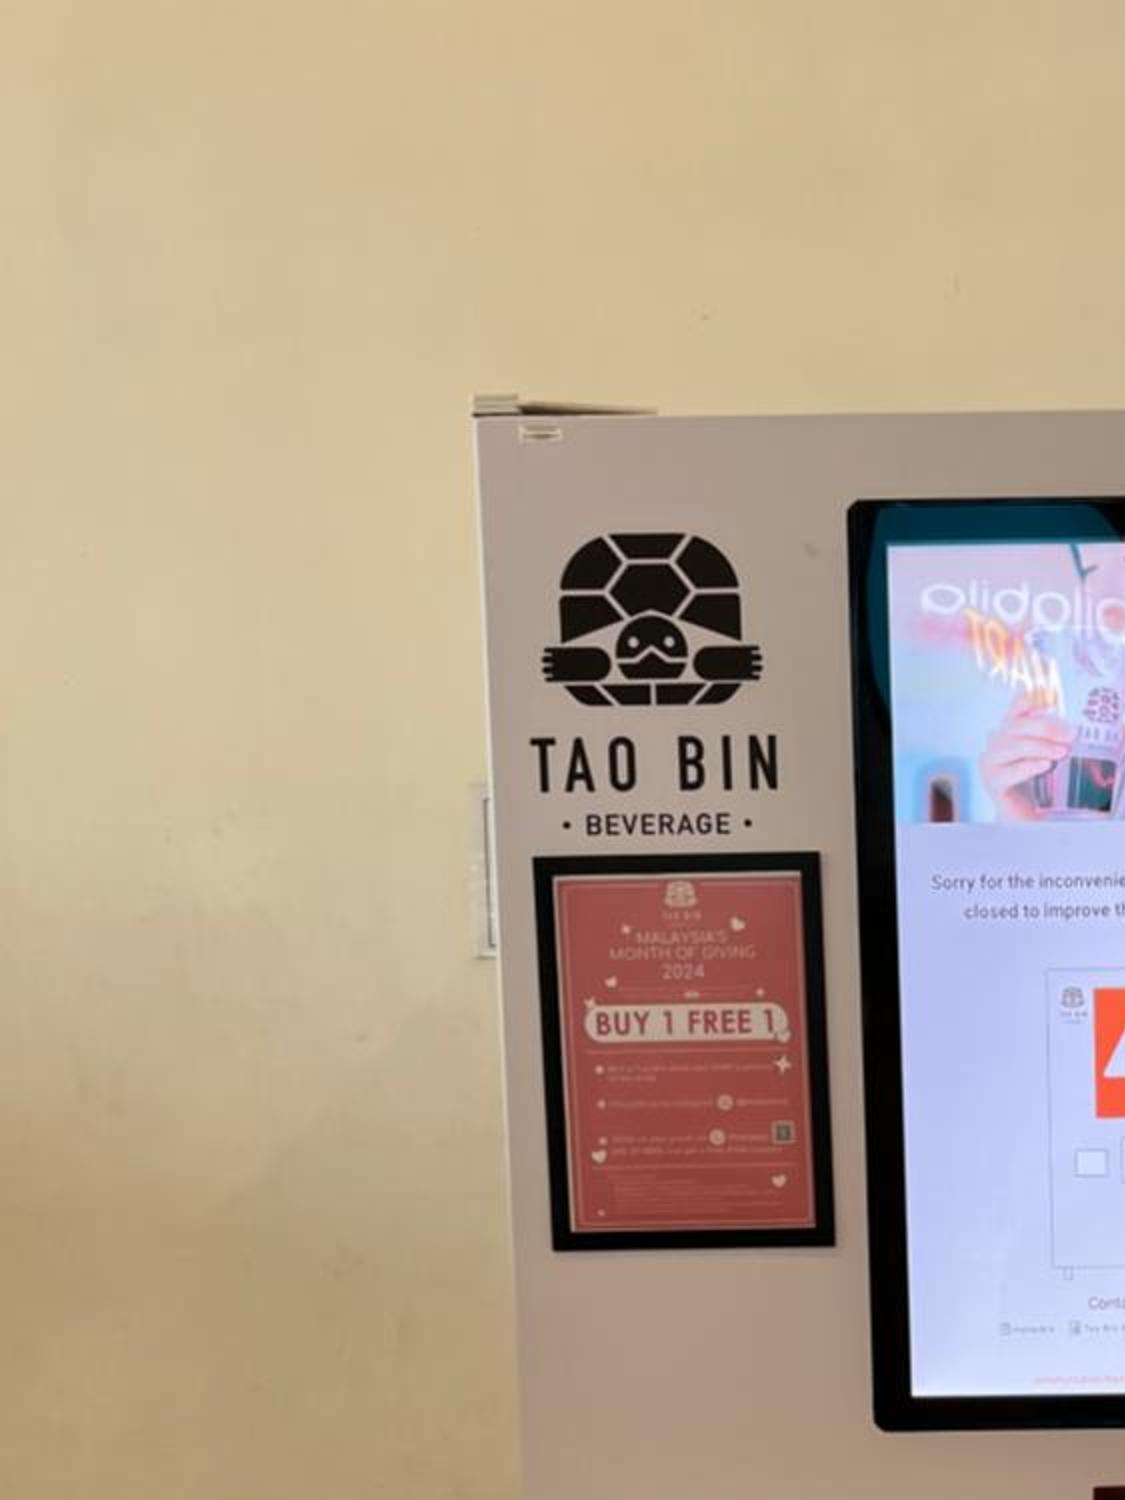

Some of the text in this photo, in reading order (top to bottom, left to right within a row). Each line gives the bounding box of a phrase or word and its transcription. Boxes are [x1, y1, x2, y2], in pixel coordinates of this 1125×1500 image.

[529, 734, 779, 793] TAO BIN
[585, 812, 731, 837] BEVERAGE
[931, 873, 975, 892] Sorry
[979, 873, 1004, 889] for
[1007, 874, 1036, 889] the
[963, 903, 1018, 920] closed
[1022, 904, 1041, 919] to
[1043, 902, 1112, 922] improve
[608, 944, 757, 961] MONTH OF GIVING
[661, 963, 706, 980] 2024
[595, 1008, 775, 1037] BUY 1 FREE 1
